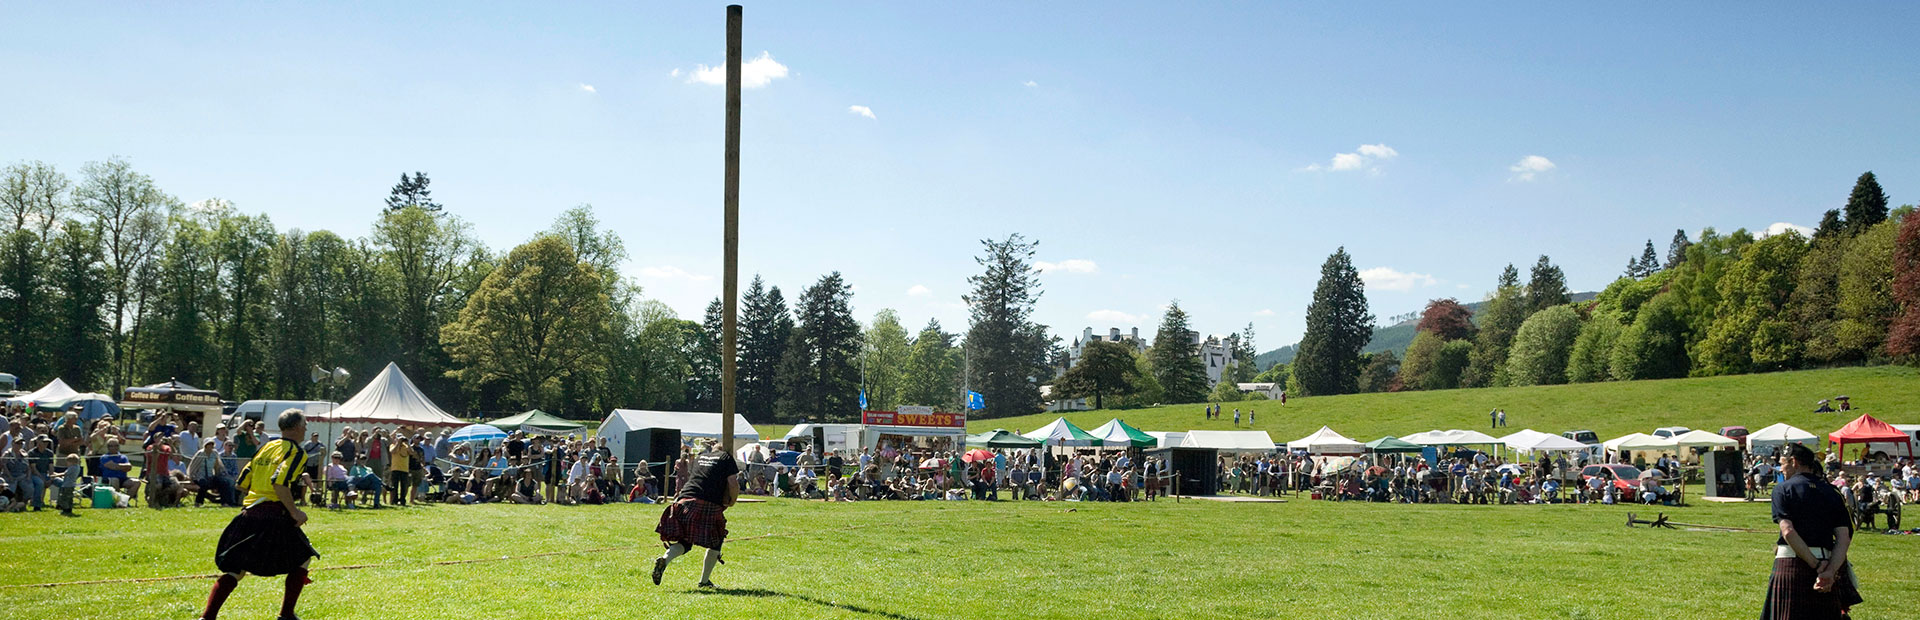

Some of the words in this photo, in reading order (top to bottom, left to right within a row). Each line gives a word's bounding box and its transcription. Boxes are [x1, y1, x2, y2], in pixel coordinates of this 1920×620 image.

[149, 392, 160, 400] Bar
[175, 393, 203, 401] Coffee
[897, 414, 952, 425] SWEETS
